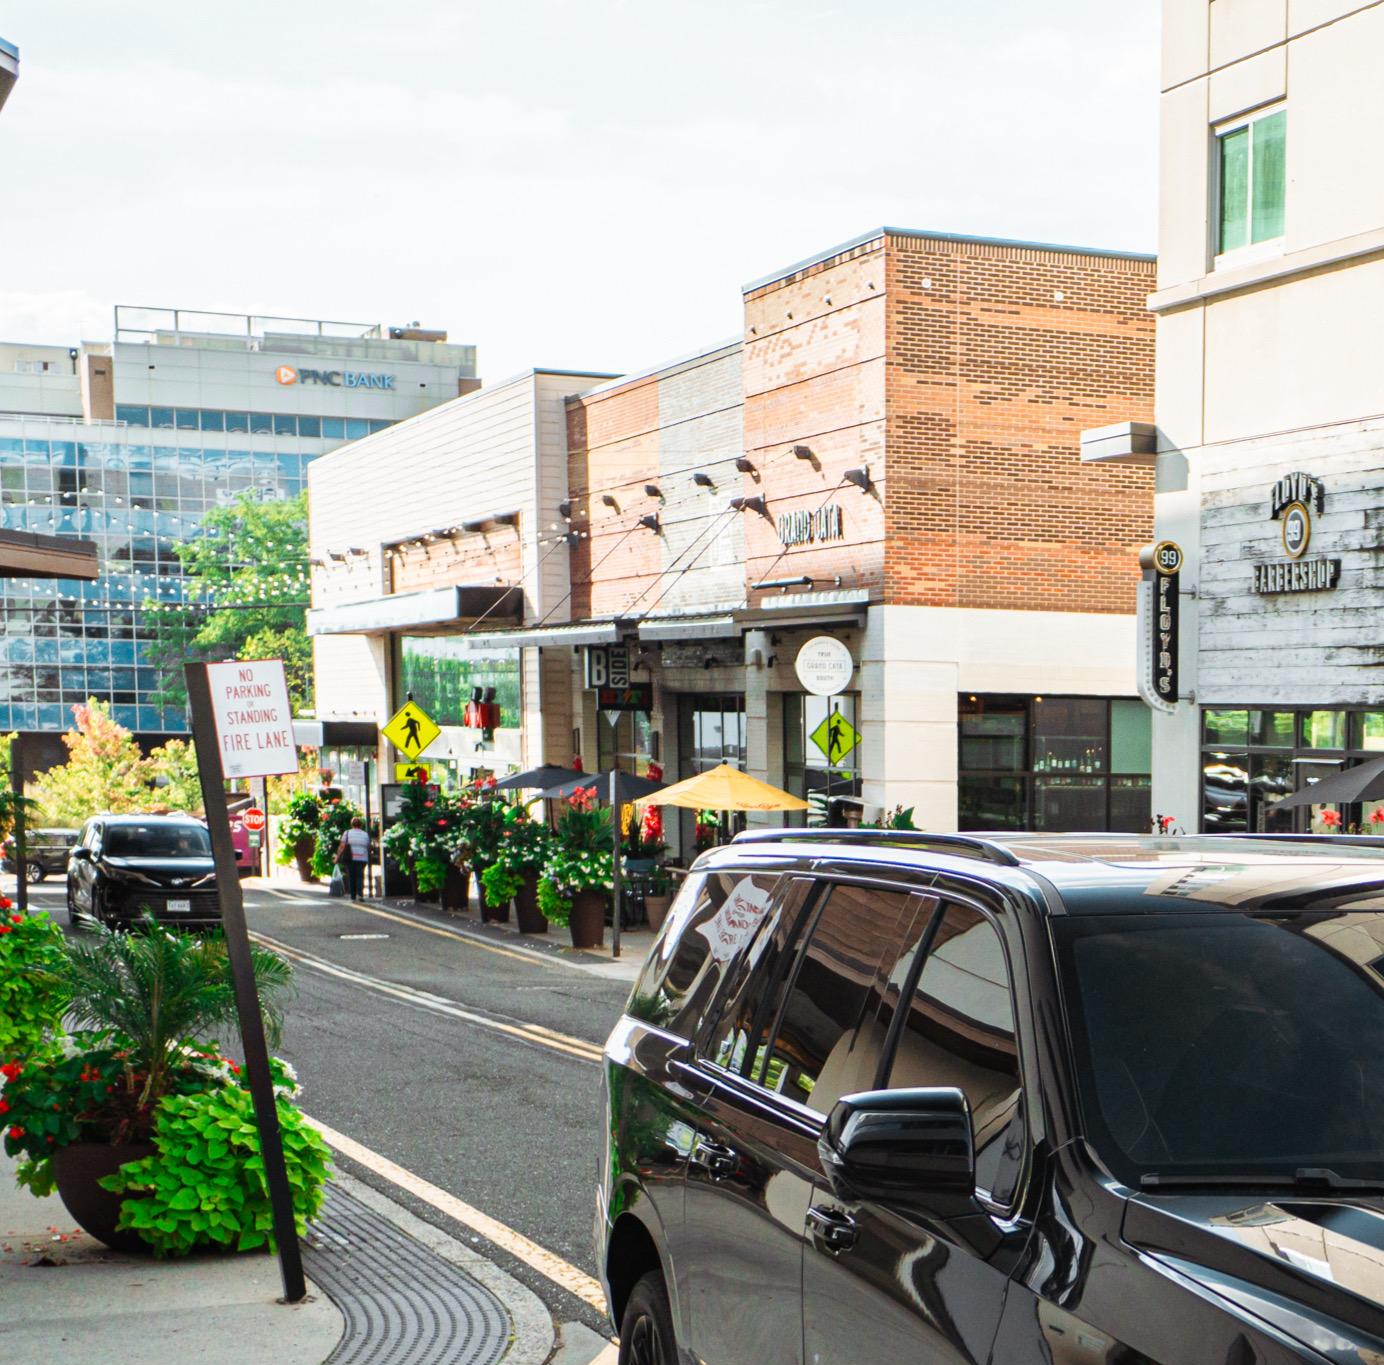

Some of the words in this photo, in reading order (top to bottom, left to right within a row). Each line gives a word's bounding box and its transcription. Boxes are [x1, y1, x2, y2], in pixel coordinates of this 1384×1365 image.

[299, 369, 341, 387] PNC
[343, 371, 396, 391] BANK
[1287, 519, 1301, 541] 99
[1160, 550, 1177, 565] 99
[1251, 560, 1337, 594] BARBERSHOP
[1159, 576, 1172, 694] FLOYD'S
[238, 668, 253, 682] NO
[591, 649, 607, 686] B
[611, 649, 627, 686] SIDE
[226, 684, 271, 699] PARKING
[227, 709, 278, 726] STANDING
[223, 733, 251, 753] FIRE
[256, 731, 290, 750] LANE
[244, 814, 265, 825] STOP
